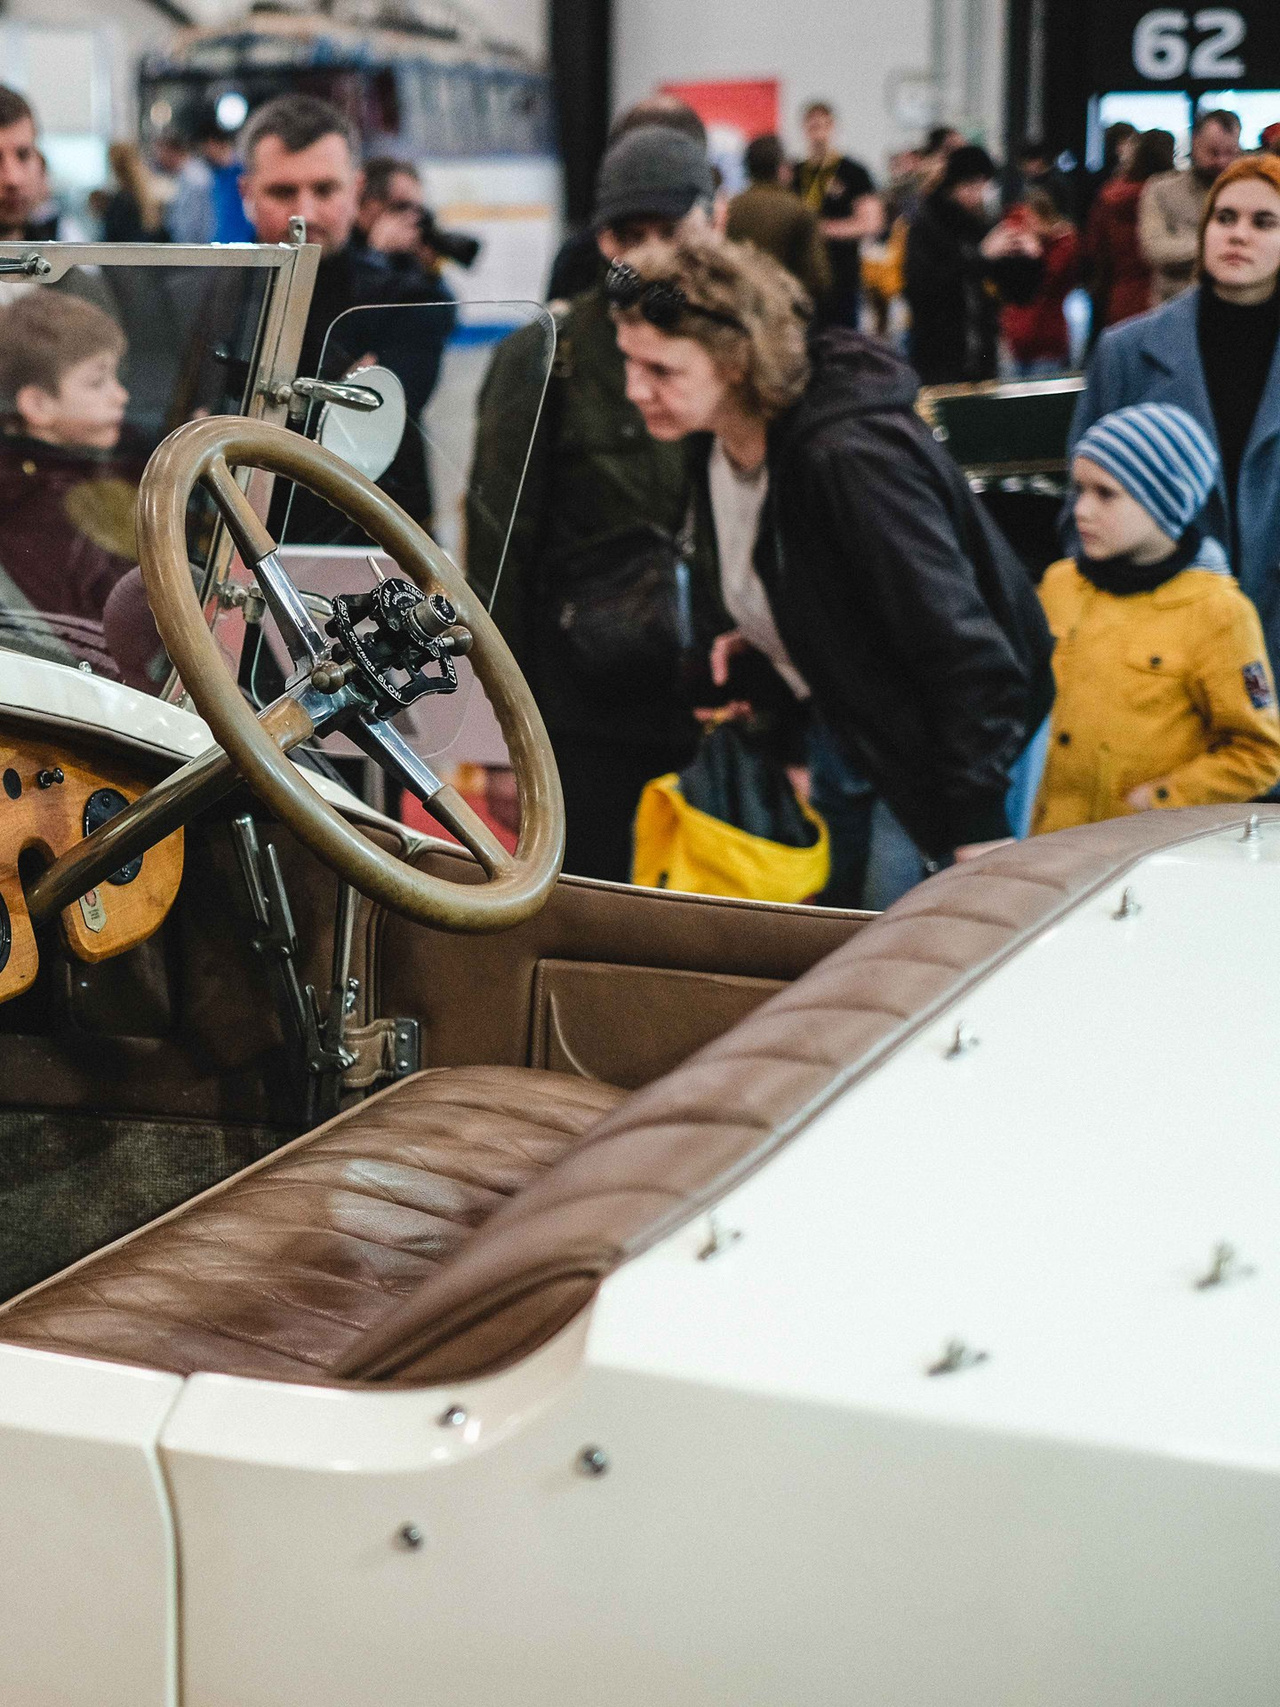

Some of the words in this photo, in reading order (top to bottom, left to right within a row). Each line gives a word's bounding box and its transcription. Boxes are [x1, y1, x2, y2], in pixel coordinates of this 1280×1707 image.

[1132, 8, 1247, 80] 62
[340, 599, 351, 623] FAST
[349, 631, 376, 672] GOVERNOR
[444, 657, 457, 684] LATE
[377, 673, 402, 699] SLOW
